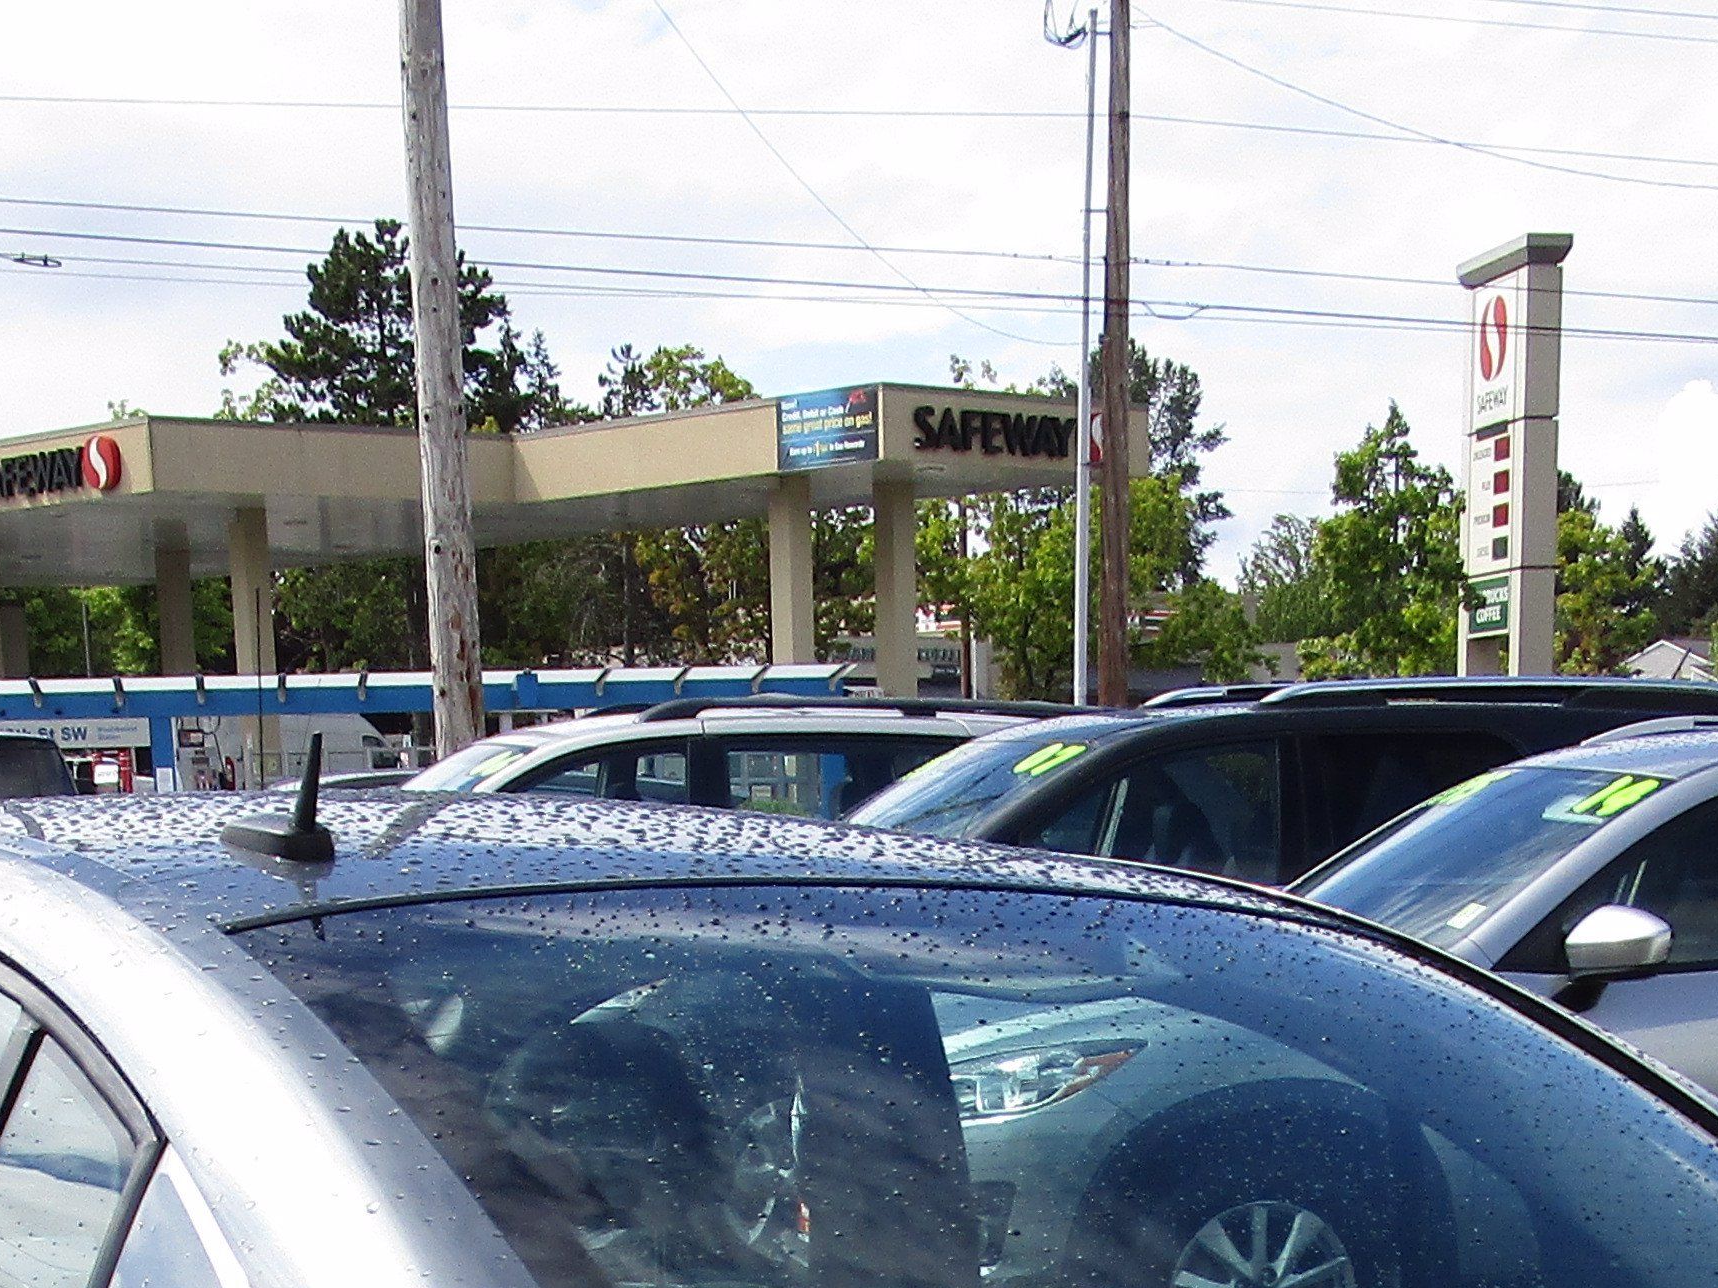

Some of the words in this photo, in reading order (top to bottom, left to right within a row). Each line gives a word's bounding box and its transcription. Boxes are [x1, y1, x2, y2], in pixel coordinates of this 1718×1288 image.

[1476, 385, 1509, 415] SAFEWAY
[914, 405, 1078, 458] SAFEWAY
[1476, 604, 1502, 624] COFFEE
[61, 727, 87, 741] SW
